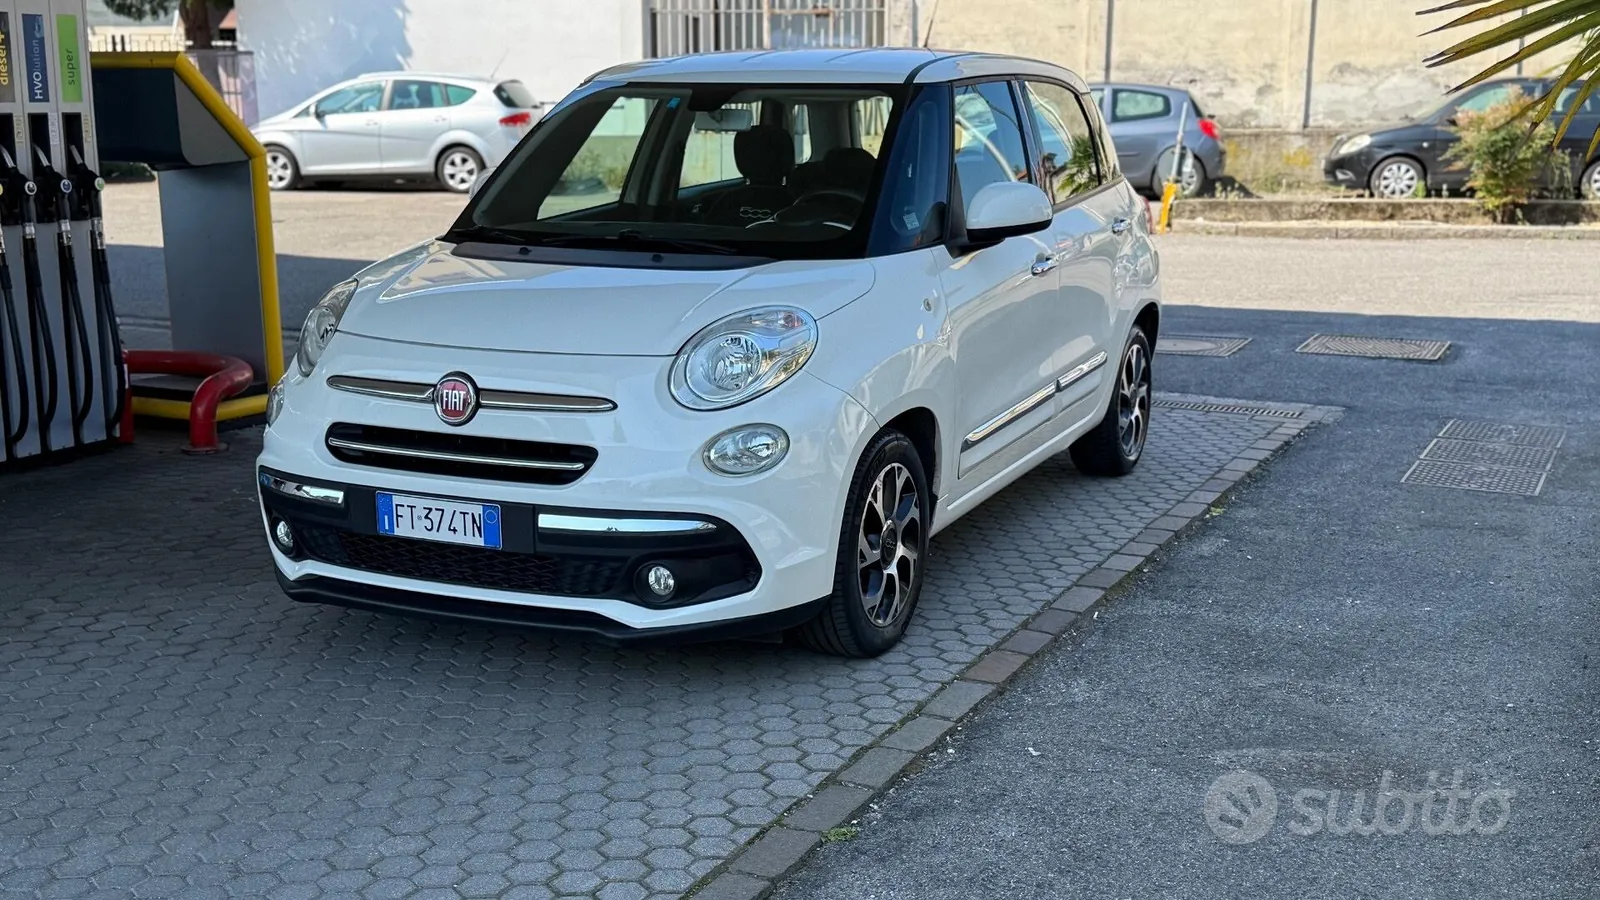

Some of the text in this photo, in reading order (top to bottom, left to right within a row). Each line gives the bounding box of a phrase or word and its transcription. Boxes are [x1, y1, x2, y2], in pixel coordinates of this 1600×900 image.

[32, 40, 44, 99] HVOlution
[65, 49, 77, 86] super
[442, 389, 466, 412] FIAT
